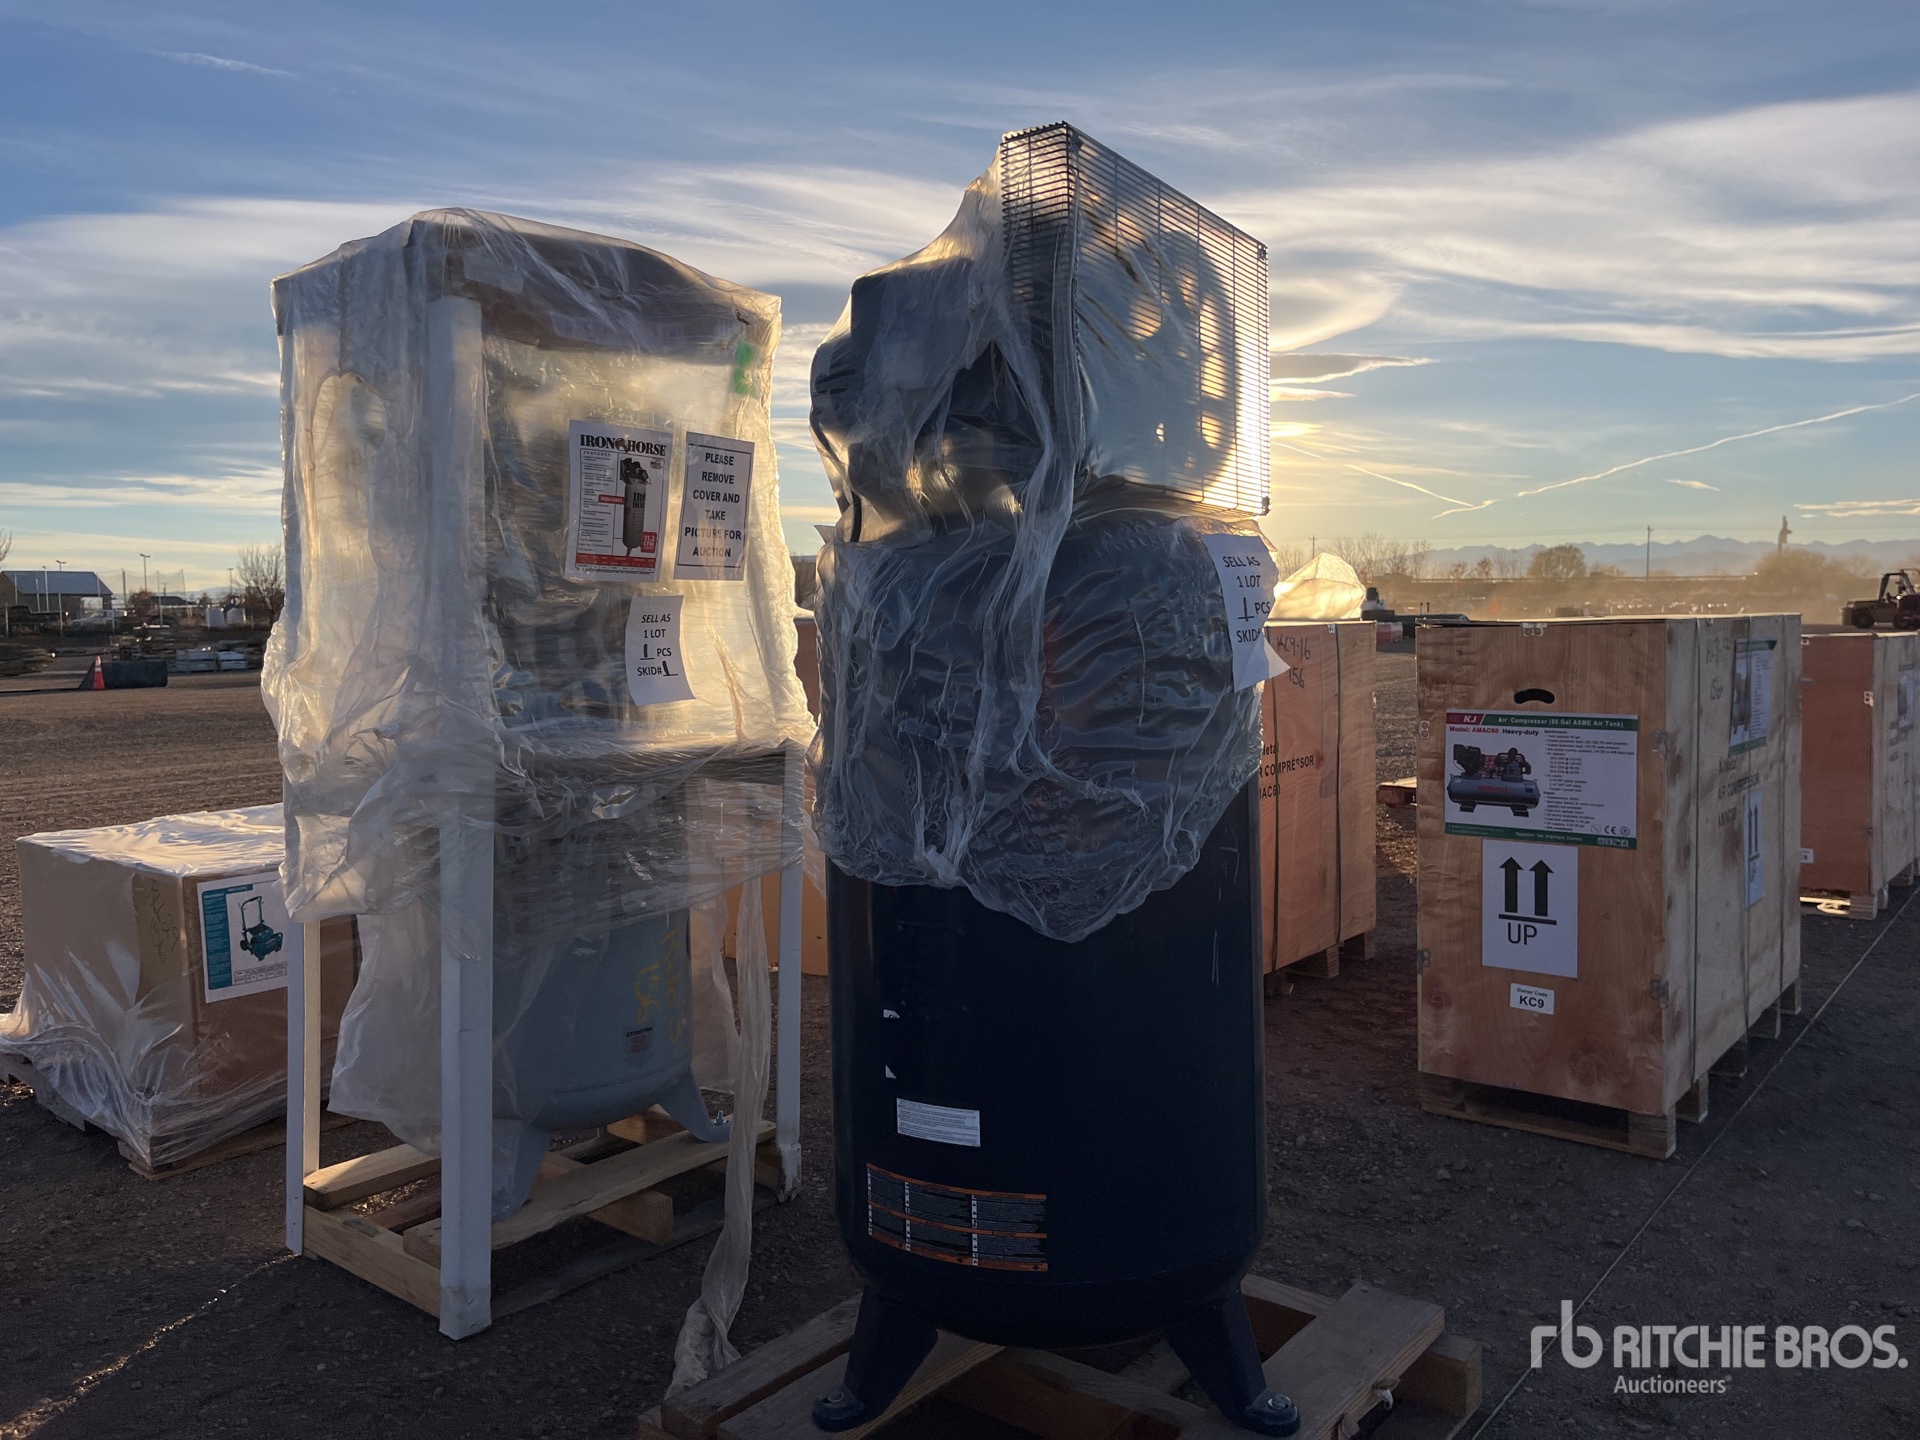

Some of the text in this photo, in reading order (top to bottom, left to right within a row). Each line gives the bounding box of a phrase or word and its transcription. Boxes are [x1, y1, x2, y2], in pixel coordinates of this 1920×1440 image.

[580, 434, 667, 456] IRON HORSE
[704, 452, 734, 466] PLEASE
[702, 472, 734, 484] REMOVE
[692, 490, 740, 504] COVER AND
[705, 510, 726, 521] TAKE
[684, 527, 742, 540] PICTURE FOR
[692, 546, 732, 558] AUCTION
[1222, 556, 1260, 568] SELL AS
[1236, 575, 1260, 588] 1 LOT
[1254, 602, 1270, 614] PCS
[641, 614, 671, 624] SELL AS
[644, 628, 666, 638] 1 LOT
[656, 648, 672, 657] PCS
[1463, 714, 1478, 723] KJ
[1510, 718, 1548, 726] Compressor
[1502, 728, 1540, 736] Heavy-duty
[1508, 922, 1538, 946] UP
[1519, 995, 1544, 1008] KC9
